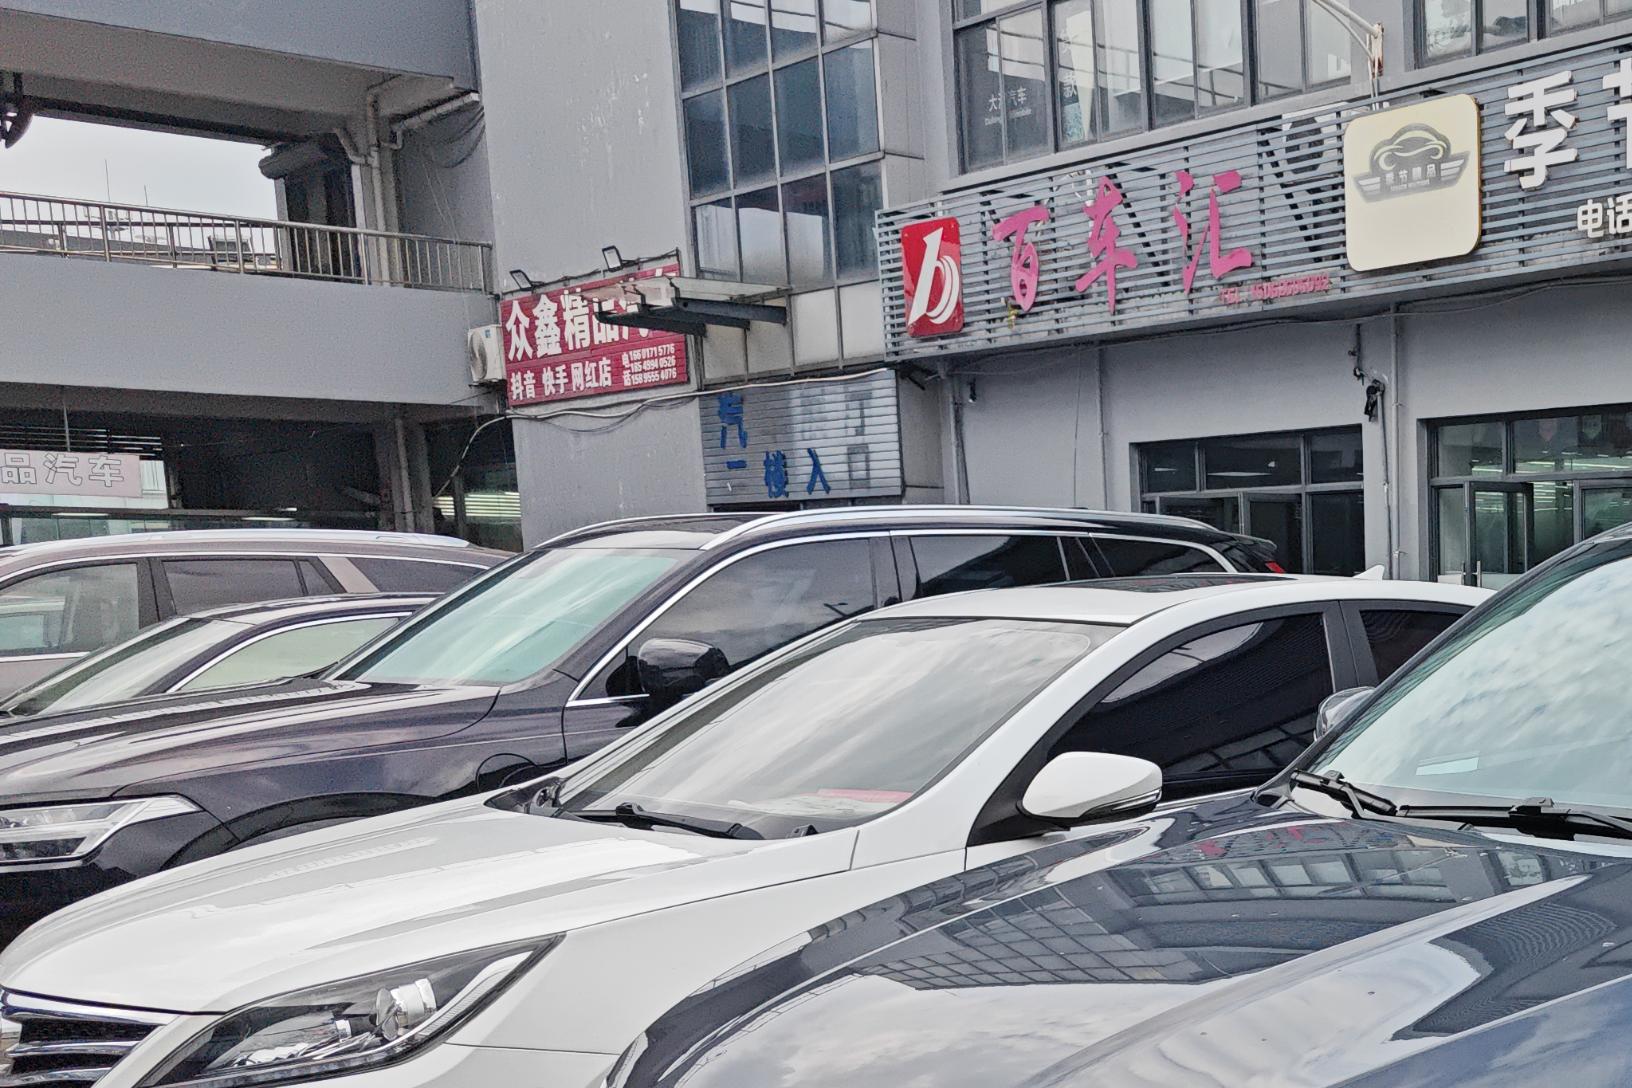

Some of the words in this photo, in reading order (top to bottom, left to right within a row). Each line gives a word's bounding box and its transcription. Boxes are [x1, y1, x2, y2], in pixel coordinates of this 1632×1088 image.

[505, 267, 678, 362] 众鑫精品
[542, 364, 568, 396] 快手
[571, 357, 613, 392] 网红店
[0, 452, 125, 487] 品汽车
